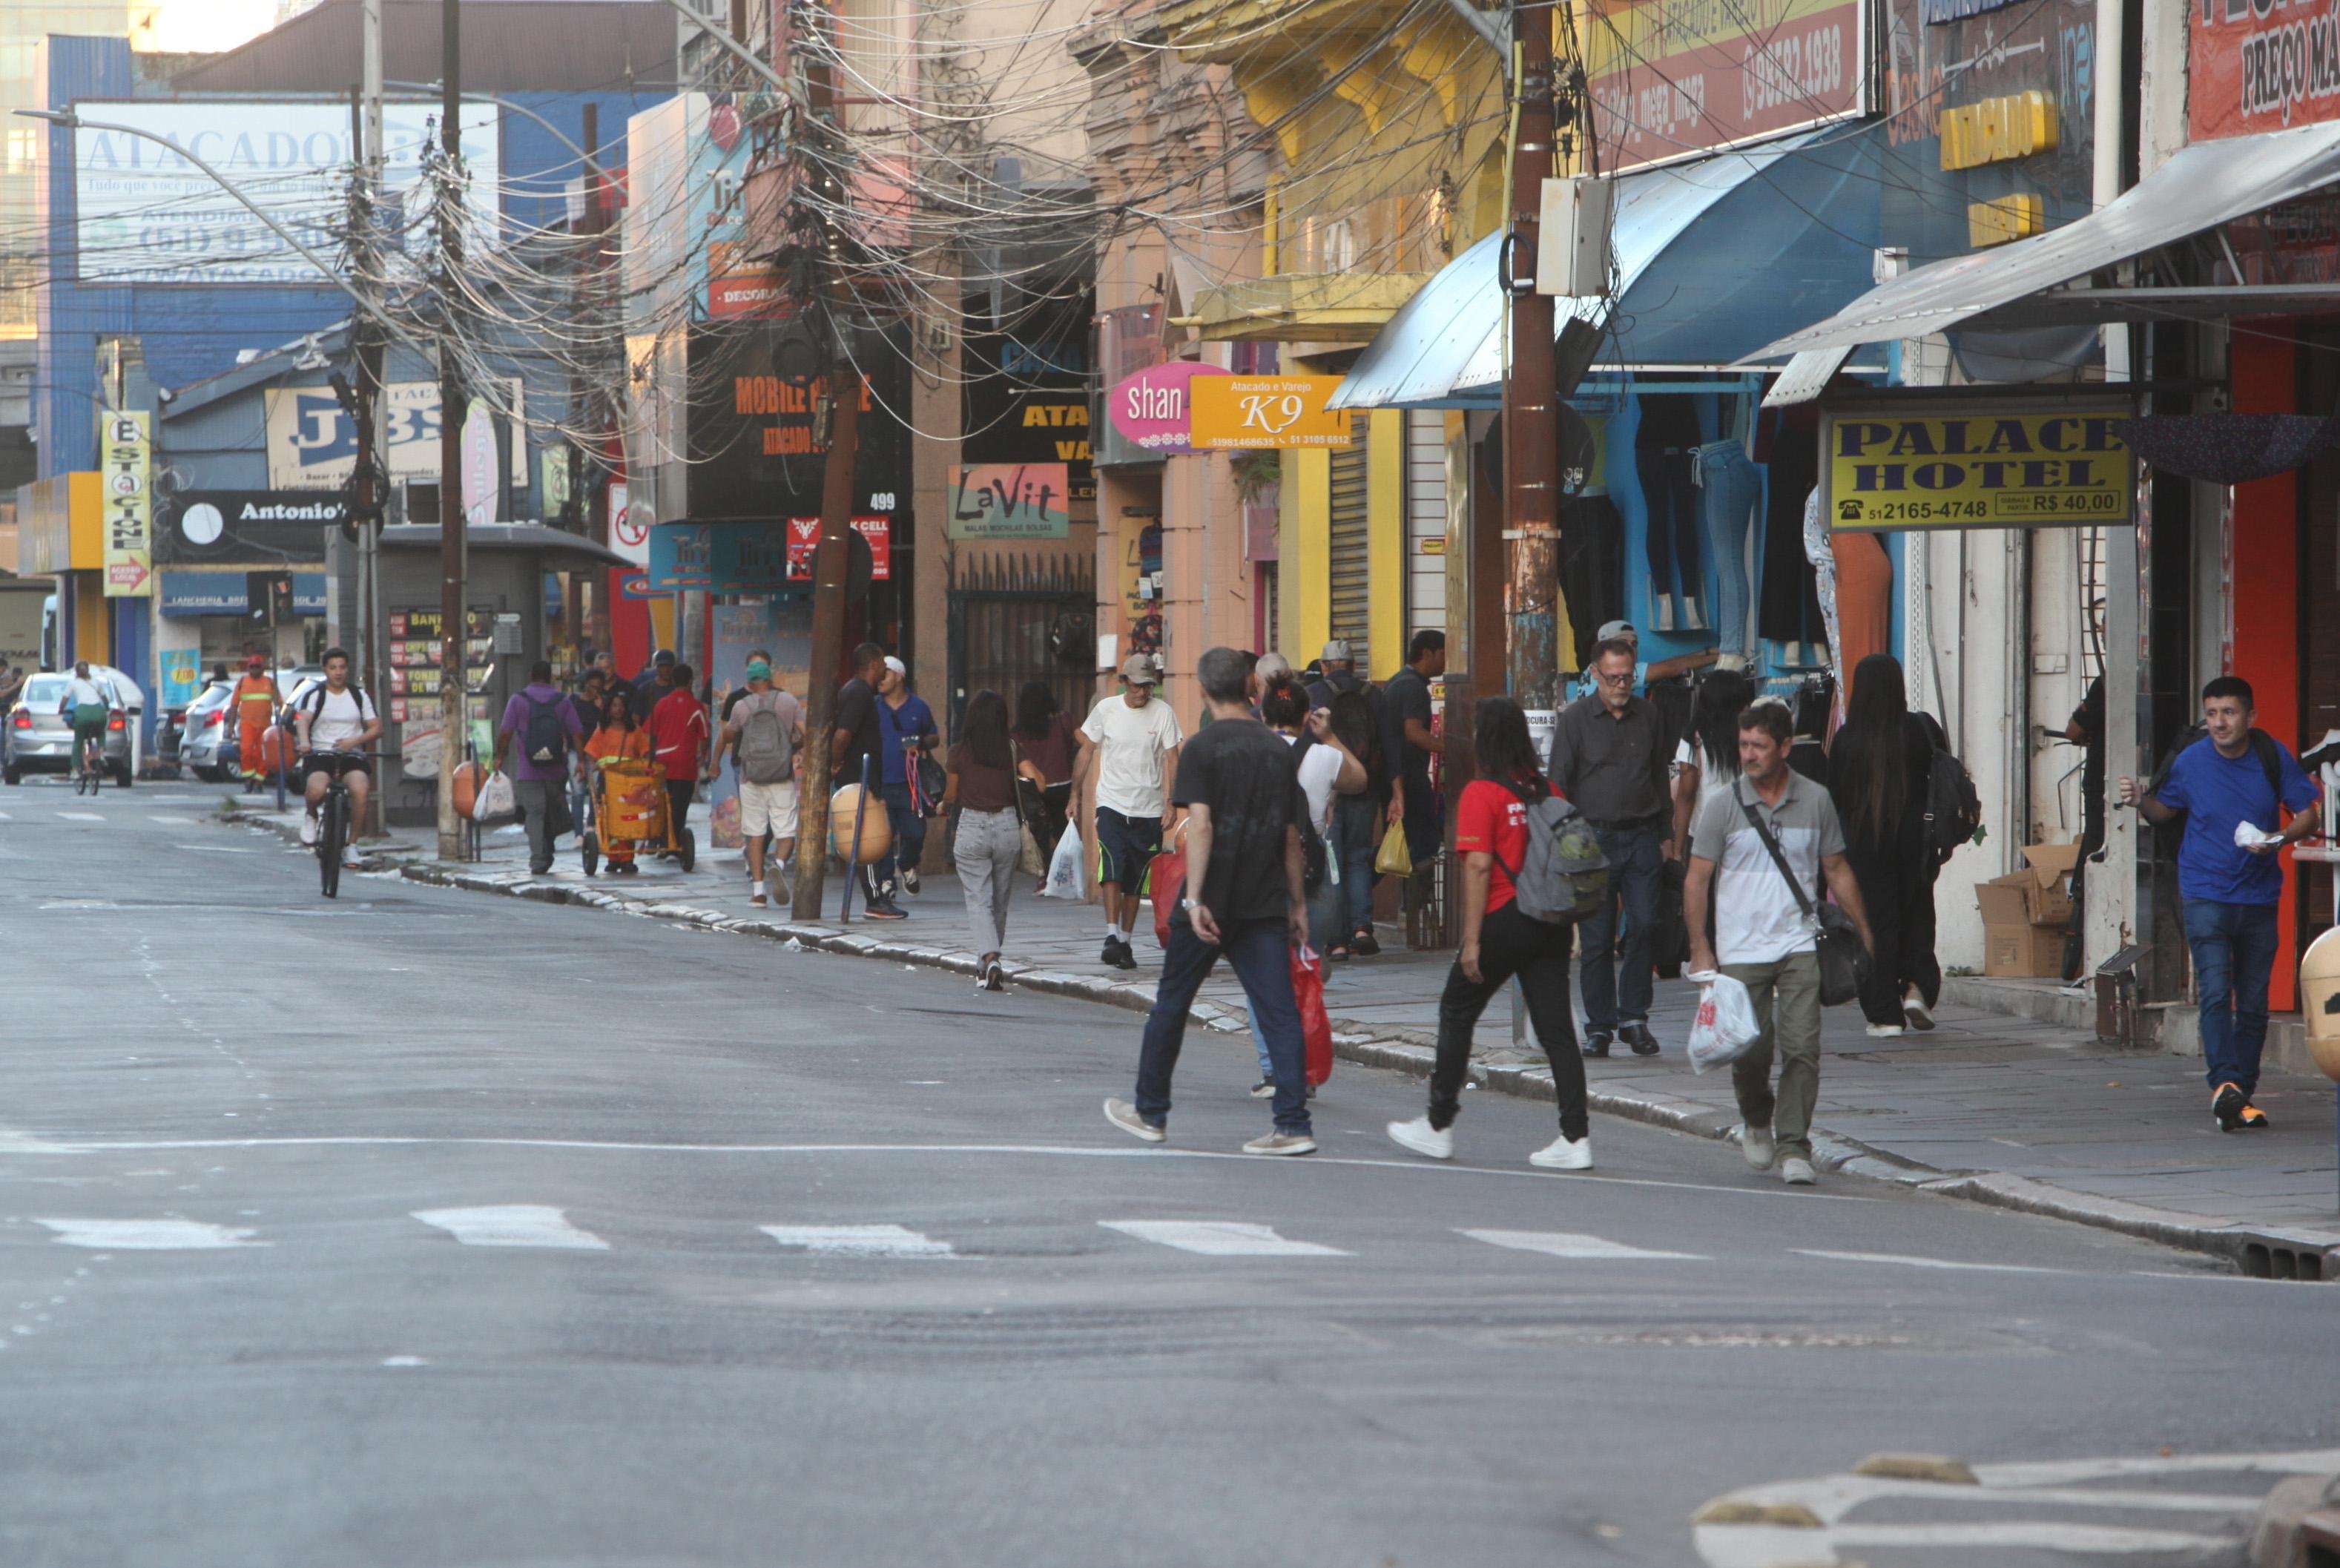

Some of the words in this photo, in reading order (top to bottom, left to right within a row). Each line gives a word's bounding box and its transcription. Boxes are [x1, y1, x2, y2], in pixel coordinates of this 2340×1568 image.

[2241, 19, 2306, 127] PREÇO
[2308, 0, 2340, 99] MÁ
[85, 130, 340, 169] ATACADO
[736, 376, 807, 414] MOBILE
[1231, 381, 1270, 392] Atacado
[1282, 381, 1311, 394] Varejo
[1023, 406, 1090, 427] ATA
[1239, 395, 1302, 434] K9
[763, 427, 811, 455] ATACADO
[1291, 435, 1300, 444] 51
[1328, 435, 1349, 444] 6512
[1837, 418, 2124, 457] PALACE
[1853, 459, 2106, 491] HOTEL
[870, 493, 895, 510] 499
[1885, 501, 1987, 520] 2165-4748
[2034, 495, 2057, 512] R$
[2064, 493, 2114, 512] 40,00
[860, 521, 889, 531] CELL
